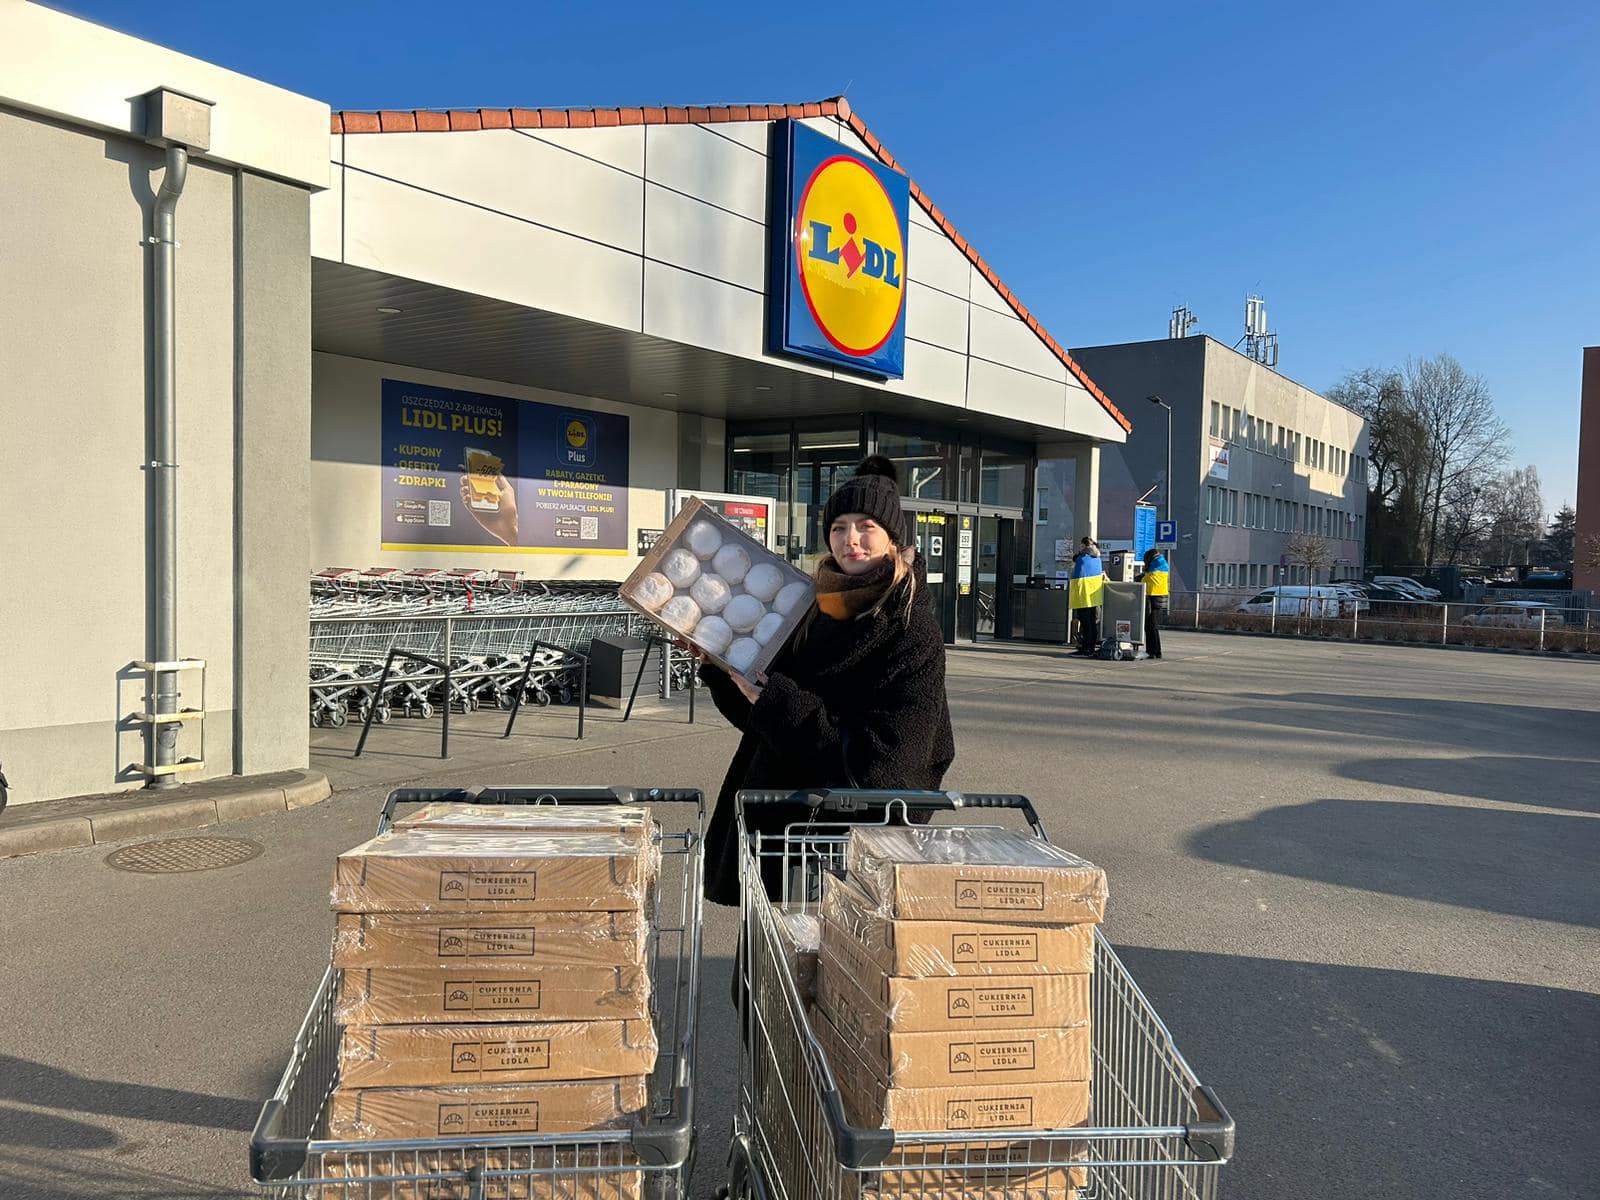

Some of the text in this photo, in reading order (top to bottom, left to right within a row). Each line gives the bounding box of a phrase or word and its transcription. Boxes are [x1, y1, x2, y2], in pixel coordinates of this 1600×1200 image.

[402, 407, 502, 437] LIDL PLUS!
[399, 444, 442, 457] KUPONY
[567, 450, 585, 462] Plus
[399, 460, 440, 472] OFERTY
[399, 474, 447, 488] ZDRAPKI
[538, 488, 547, 496] W
[547, 489, 573, 498] TWOIM
[1160, 523, 1172, 540] P
[1113, 556, 1120, 565] P
[986, 886, 1036, 894] CUKIERNIA
[978, 993, 1026, 1001] CUKIERNIA
[487, 1046, 541, 1054] CUKIERNIA
[980, 1047, 1027, 1055] CUKIERNIA
[474, 1108, 530, 1116] CUKIERNIA
[977, 1103, 1025, 1112] CUKIERNIA
[990, 1114, 1015, 1122] LIDLA
